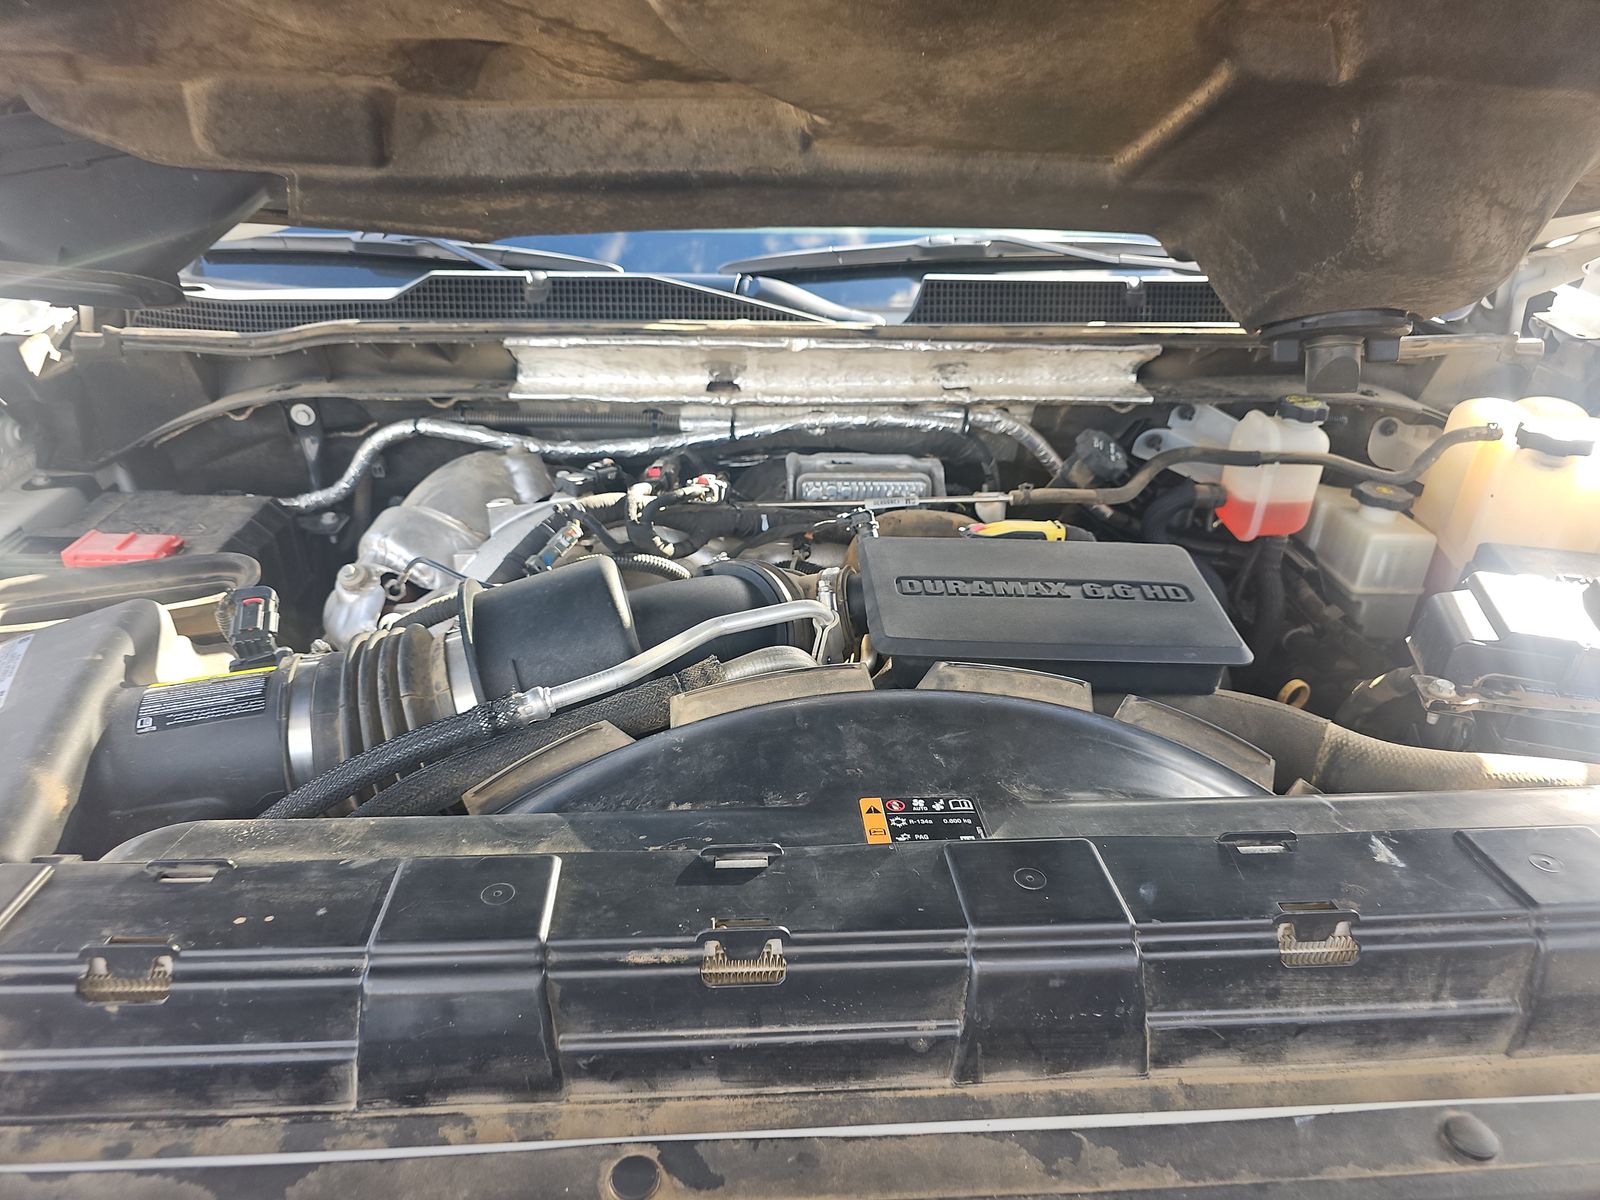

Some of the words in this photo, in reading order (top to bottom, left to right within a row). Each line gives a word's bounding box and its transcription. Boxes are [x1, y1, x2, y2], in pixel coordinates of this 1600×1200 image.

[900, 578, 1071, 598] DURAMAX
[1081, 581, 1136, 600] 6.6
[1139, 583, 1190, 602] HD
